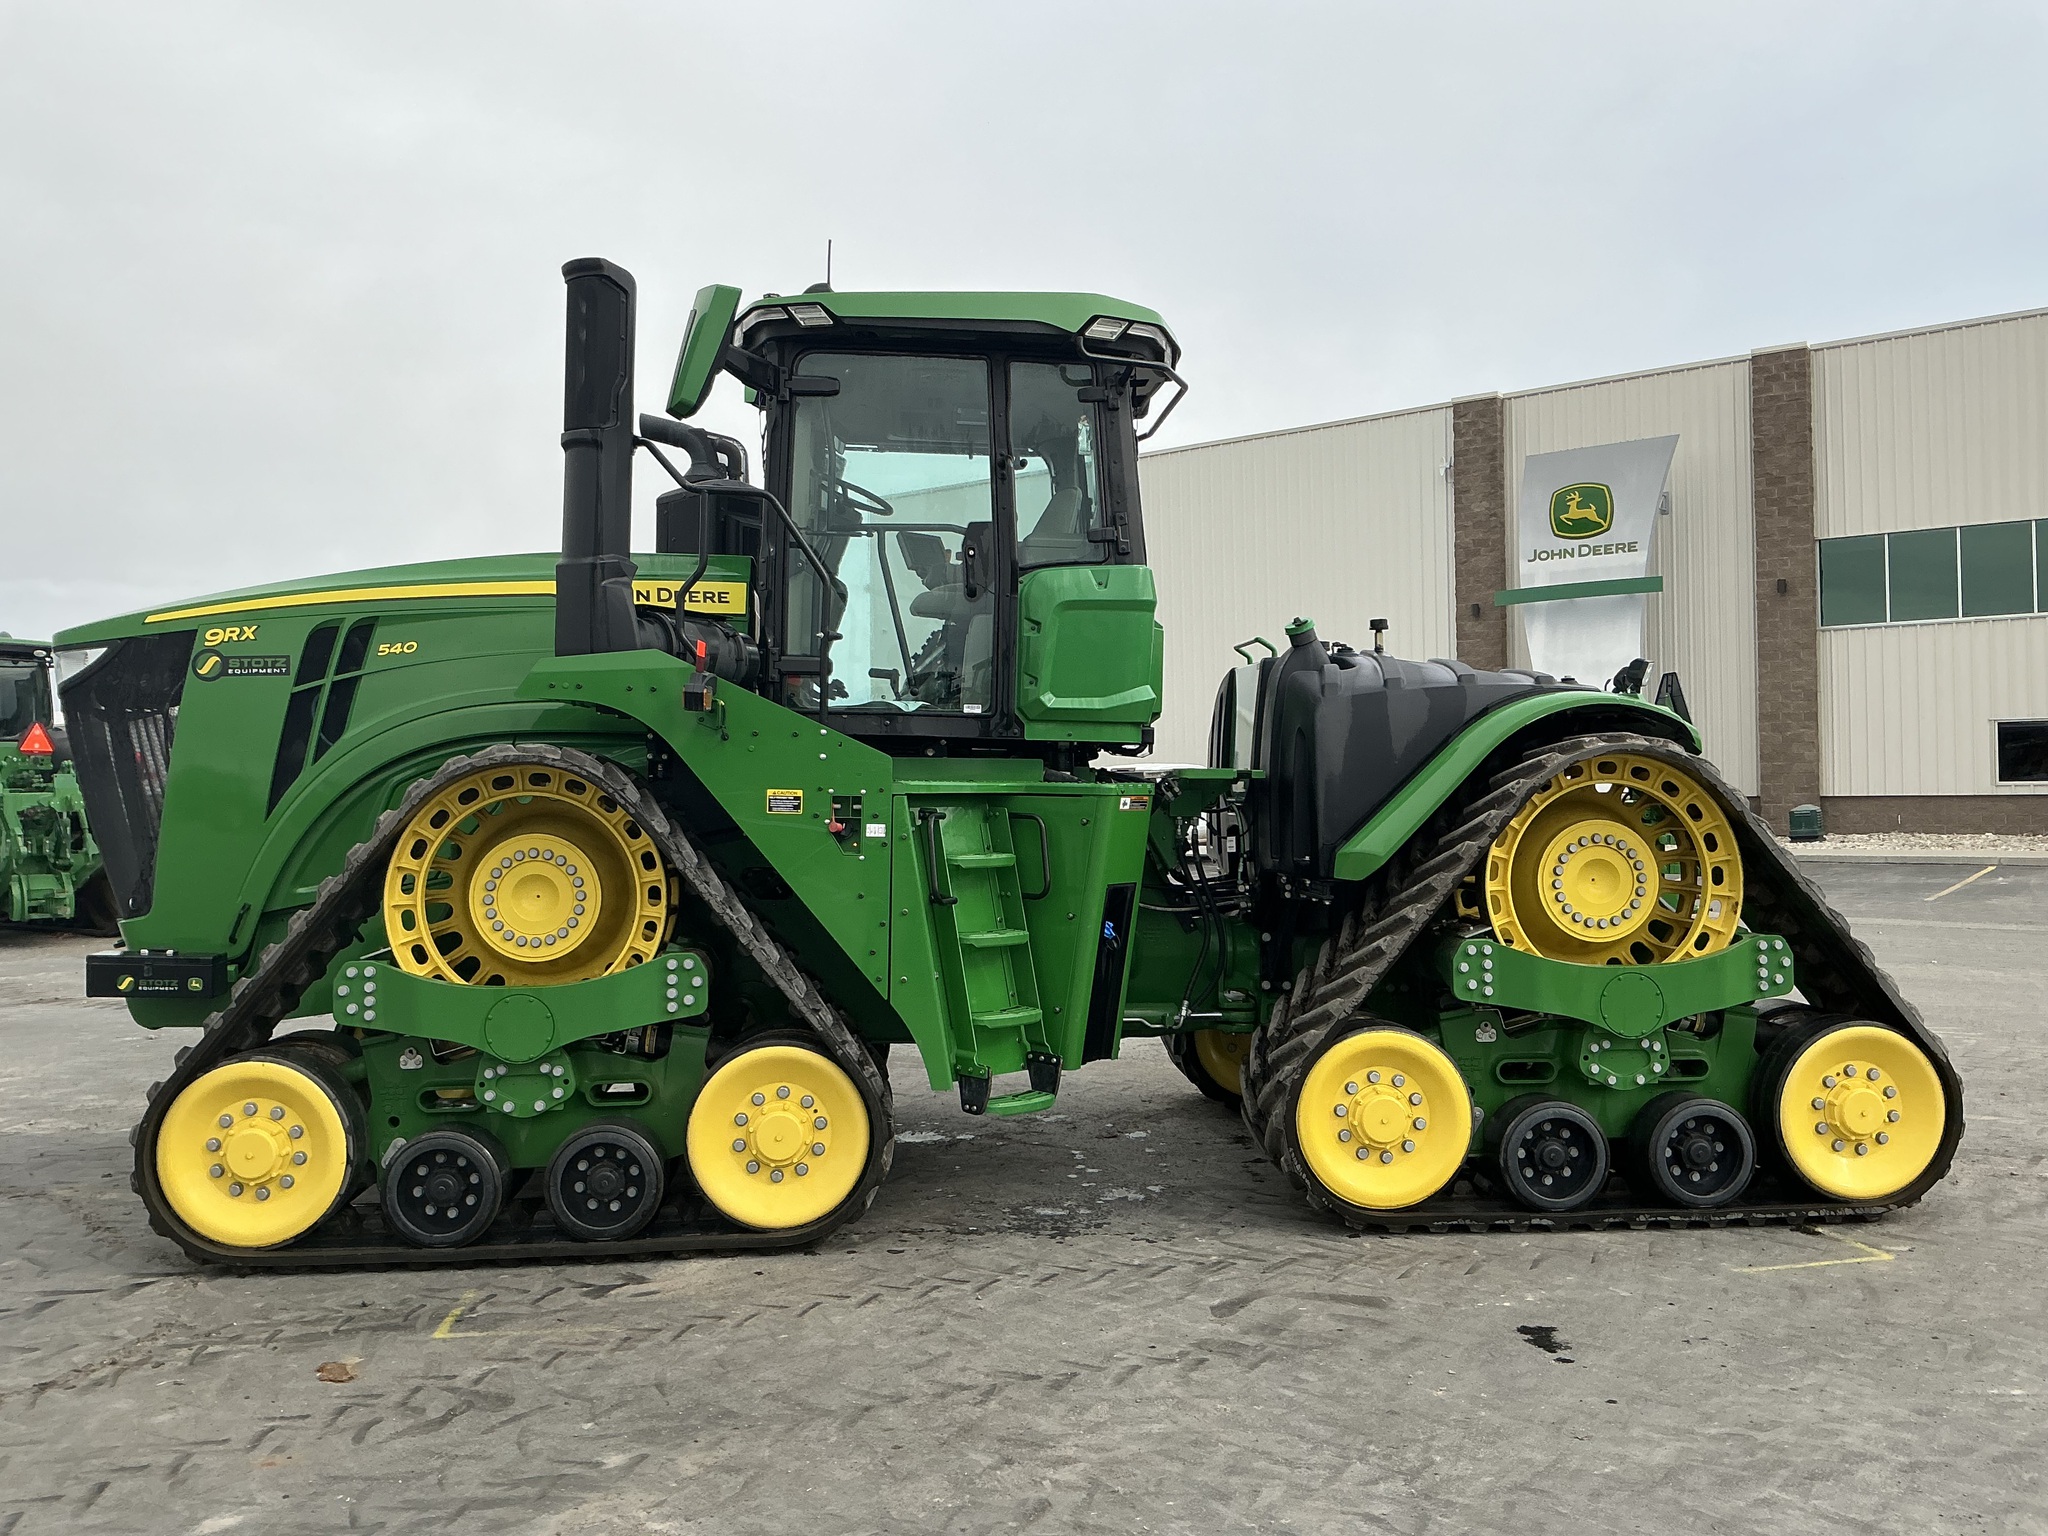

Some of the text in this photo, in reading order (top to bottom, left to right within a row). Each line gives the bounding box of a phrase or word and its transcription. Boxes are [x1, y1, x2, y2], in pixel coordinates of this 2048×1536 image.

[1527, 541, 1639, 563] JOHN DEERE
[203, 625, 259, 647] 9RX
[377, 641, 418, 656] 540
[228, 657, 288, 668] STOTZ
